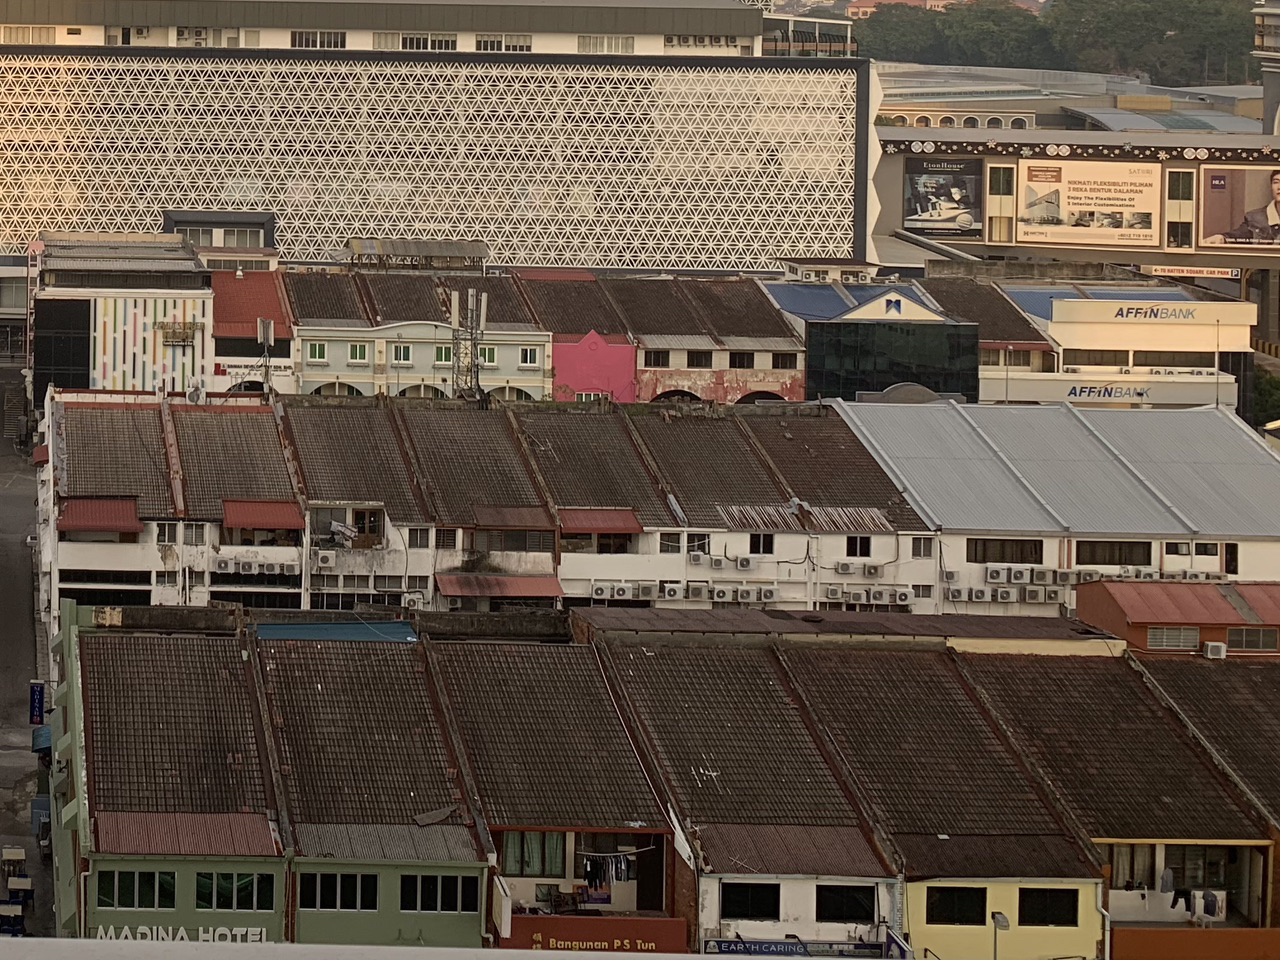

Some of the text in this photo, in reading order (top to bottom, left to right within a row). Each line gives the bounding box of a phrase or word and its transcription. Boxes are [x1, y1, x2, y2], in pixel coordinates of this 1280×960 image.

[549, 938, 609, 951] Bangunan
[636, 939, 656, 950] Tun
[762, 944, 804, 953] CARING
